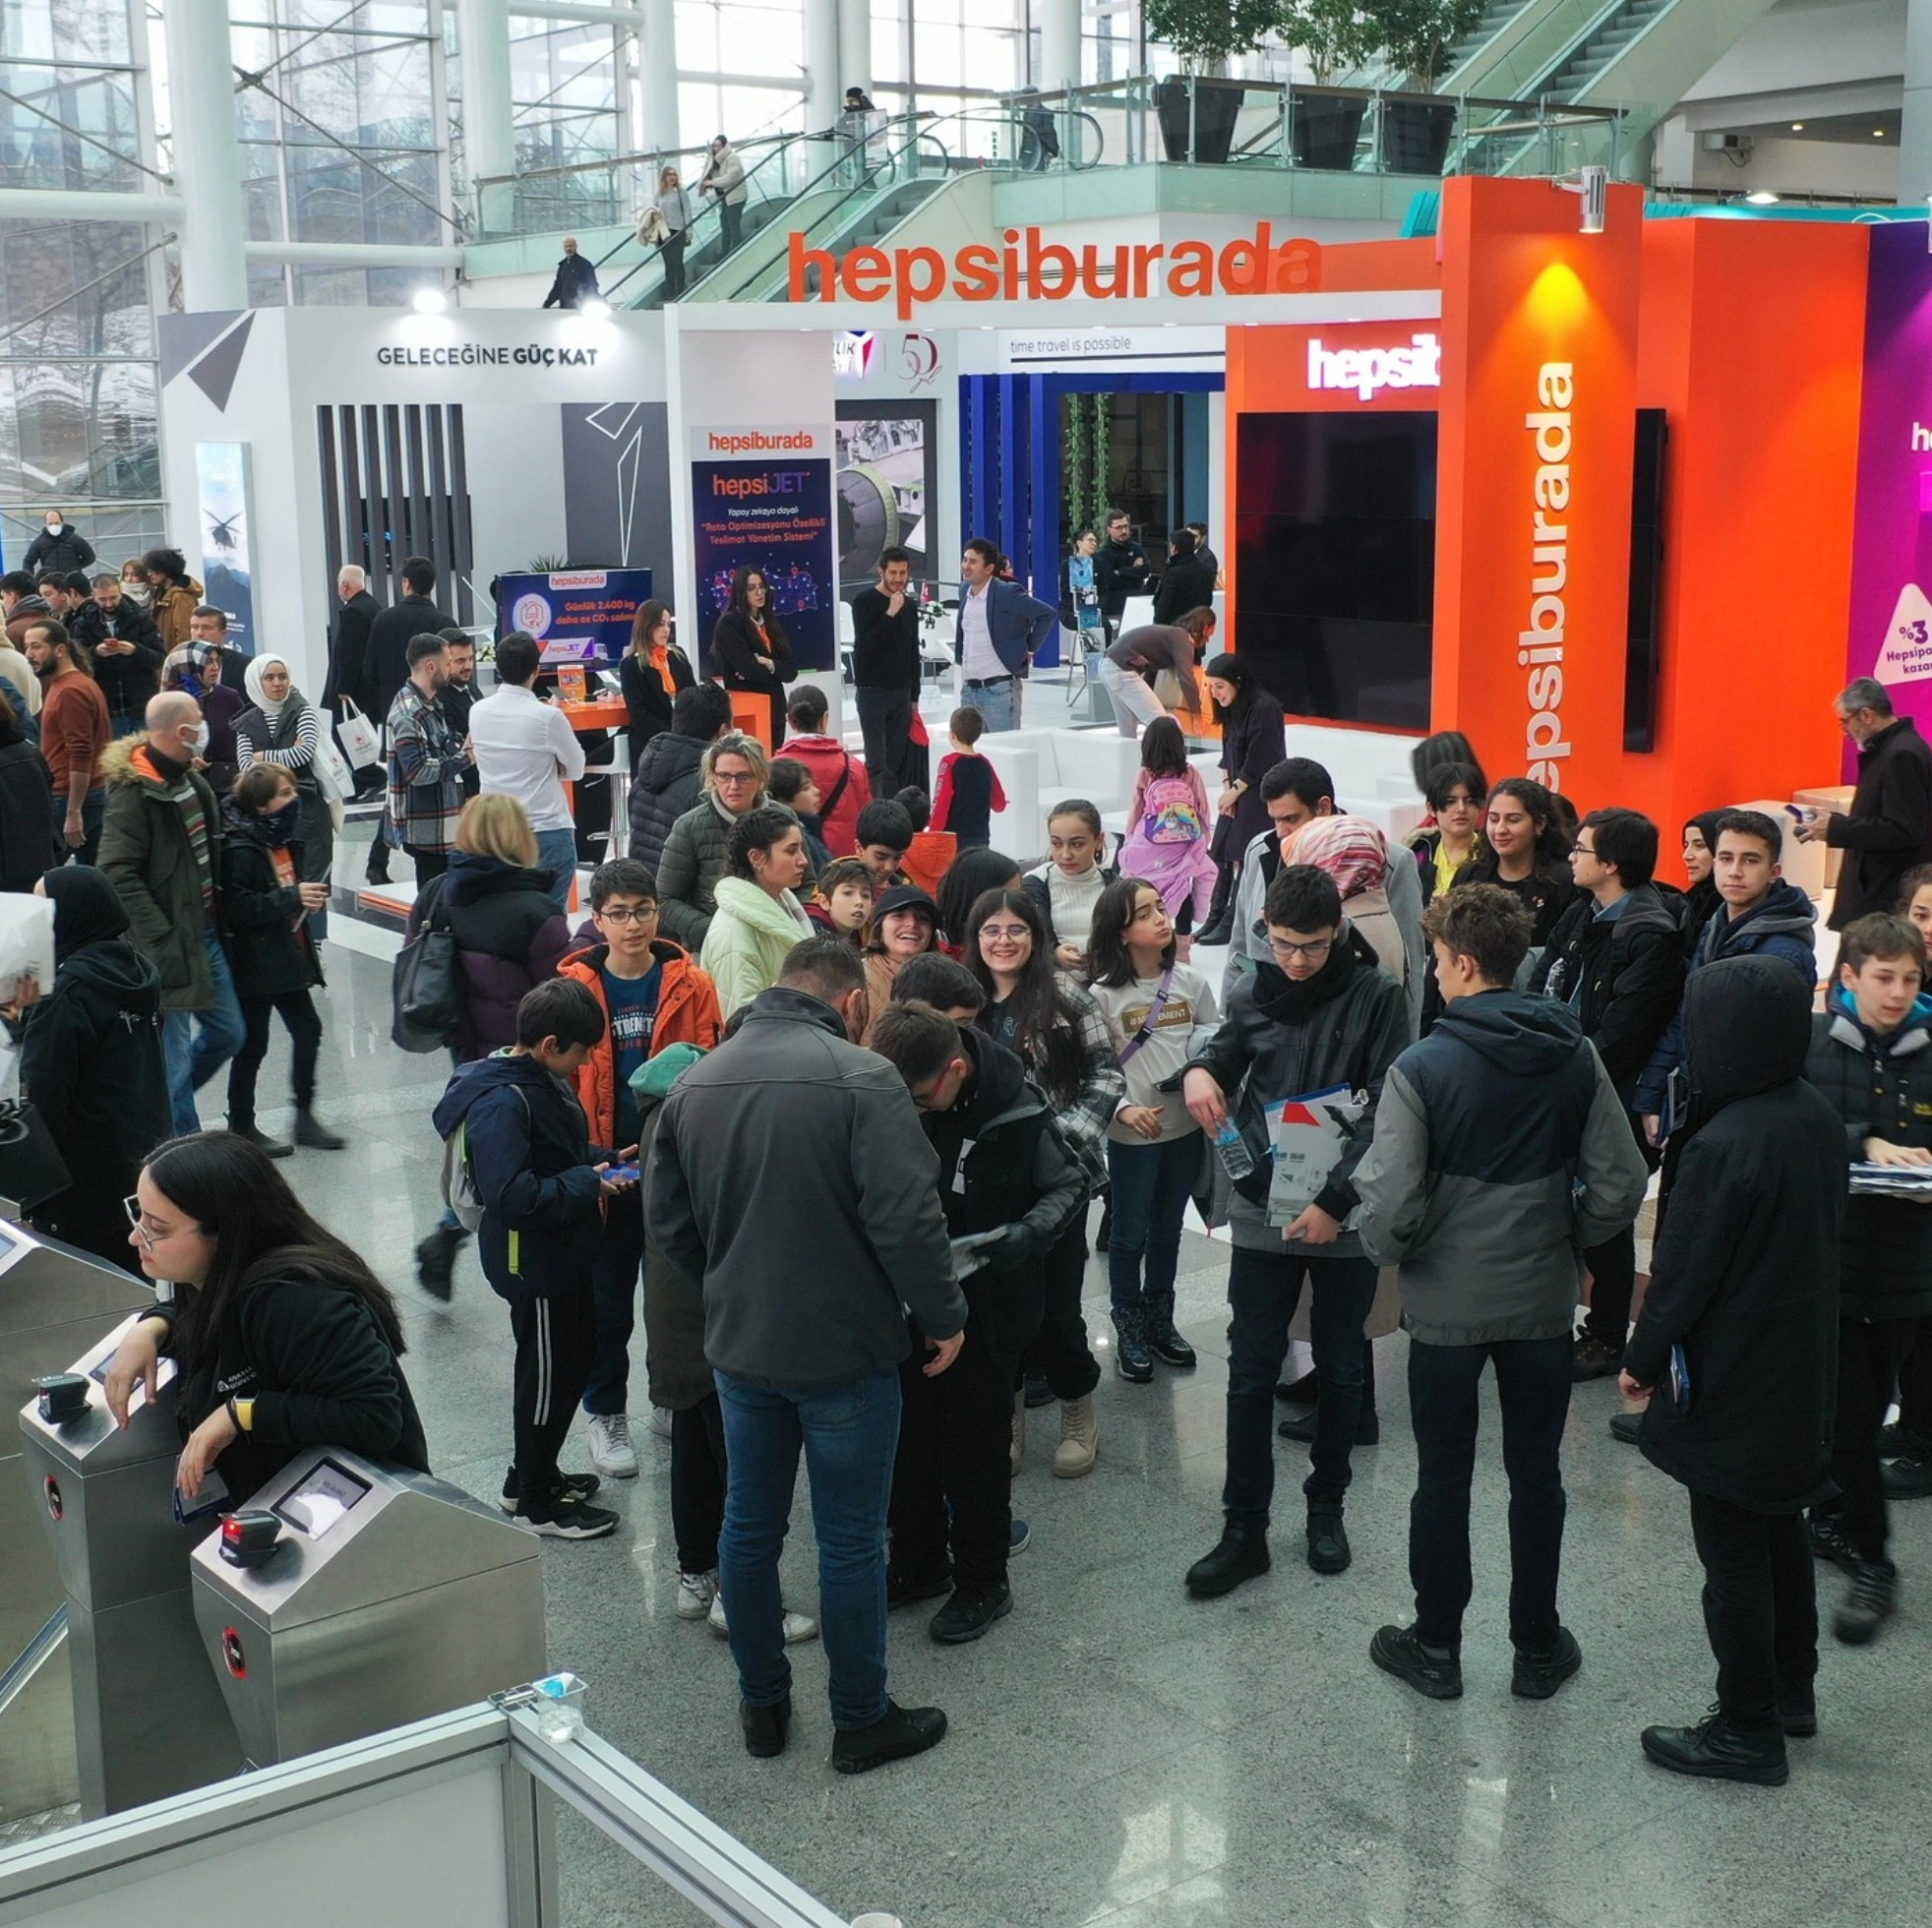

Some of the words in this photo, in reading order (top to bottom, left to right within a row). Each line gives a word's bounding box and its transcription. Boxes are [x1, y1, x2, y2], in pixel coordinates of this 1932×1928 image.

[788, 221, 1323, 322] hepsiburada
[1010, 339, 1035, 353] time
[1037, 338, 1069, 352] travel
[1072, 338, 1081, 351] is
[1083, 335, 1132, 354] possible
[377, 343, 510, 365] GELECEĞİNE
[513, 344, 555, 368] GÜÇ
[559, 348, 598, 366] KAT
[709, 431, 814, 454] hepsiburada
[713, 472, 811, 500] hepsiJET
[728, 519, 791, 532] Optimizasyonu
[709, 535, 746, 546] Teslimat
[748, 533, 782, 544] Yönetim
[551, 574, 605, 586] hepsiburada
[1899, 620, 1929, 644] %3
[1902, 662, 1932, 675] kaza
